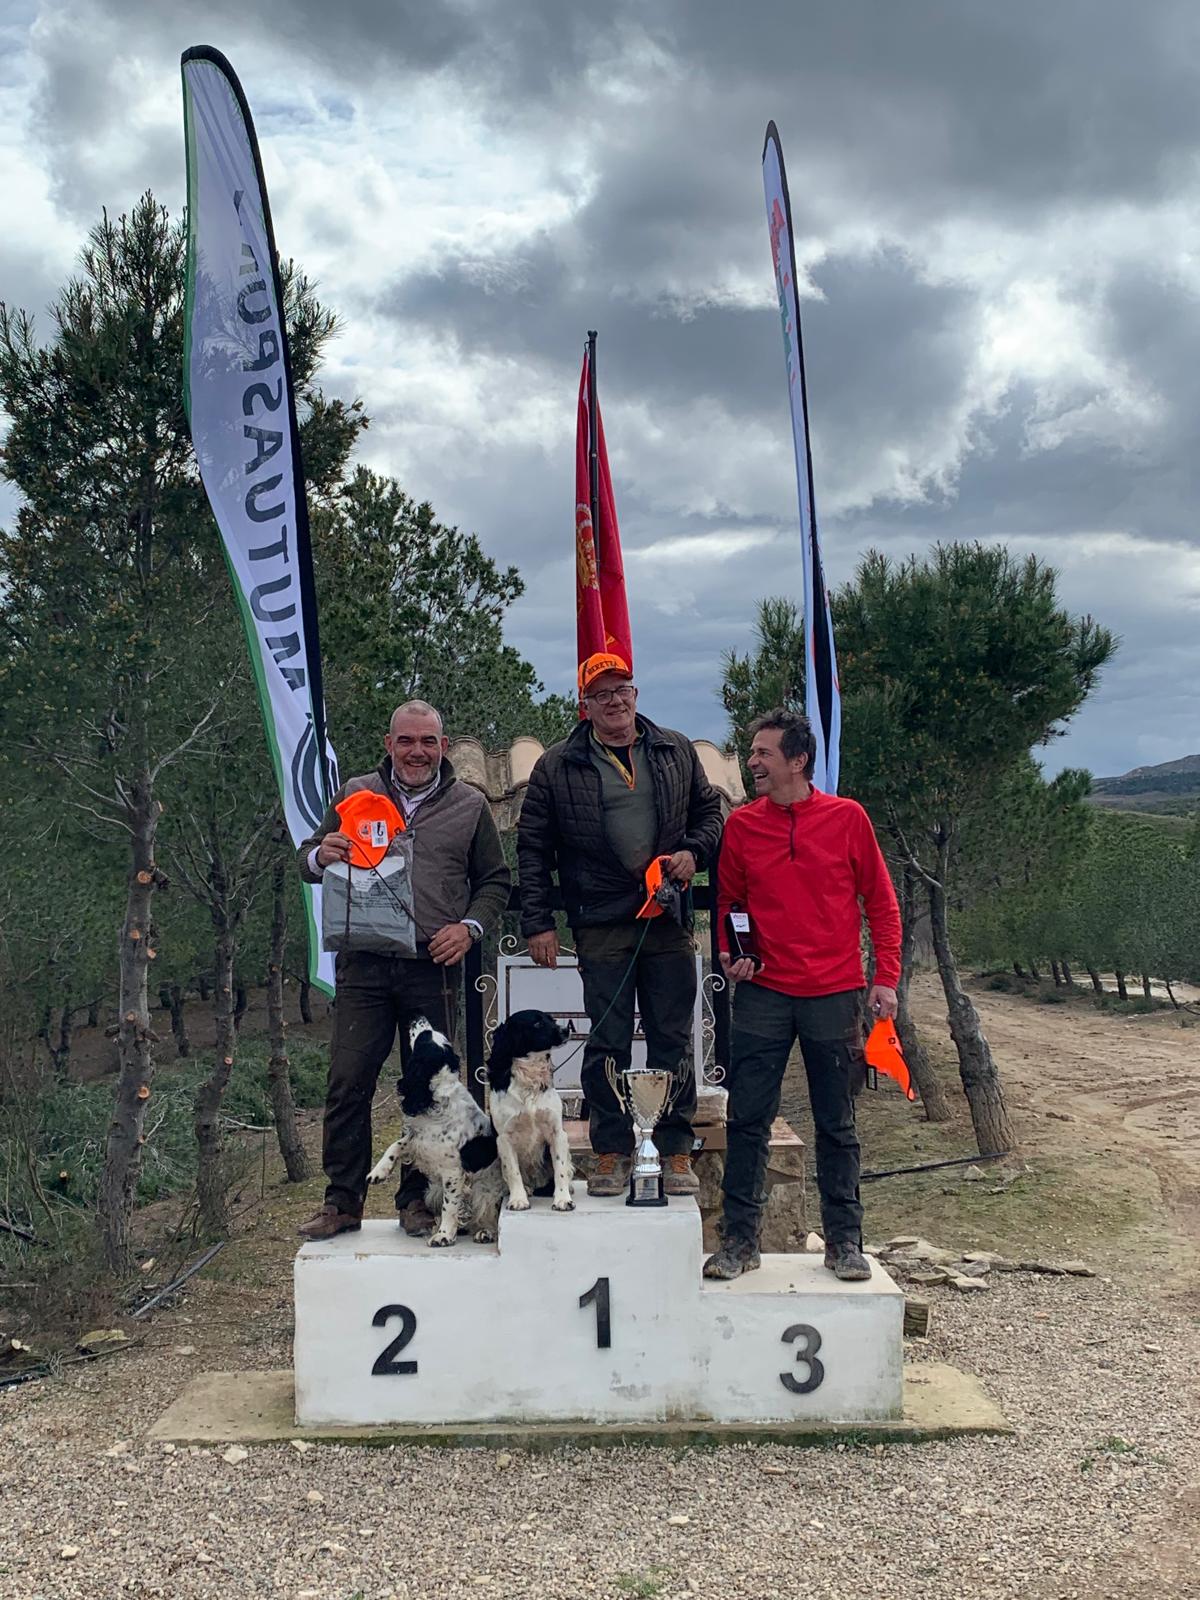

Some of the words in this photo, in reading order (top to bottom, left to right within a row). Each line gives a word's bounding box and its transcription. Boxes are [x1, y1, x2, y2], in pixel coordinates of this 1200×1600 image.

[371, 1304, 418, 1375] 2
[578, 1276, 612, 1349] 1
[779, 1324, 825, 1394] 3
